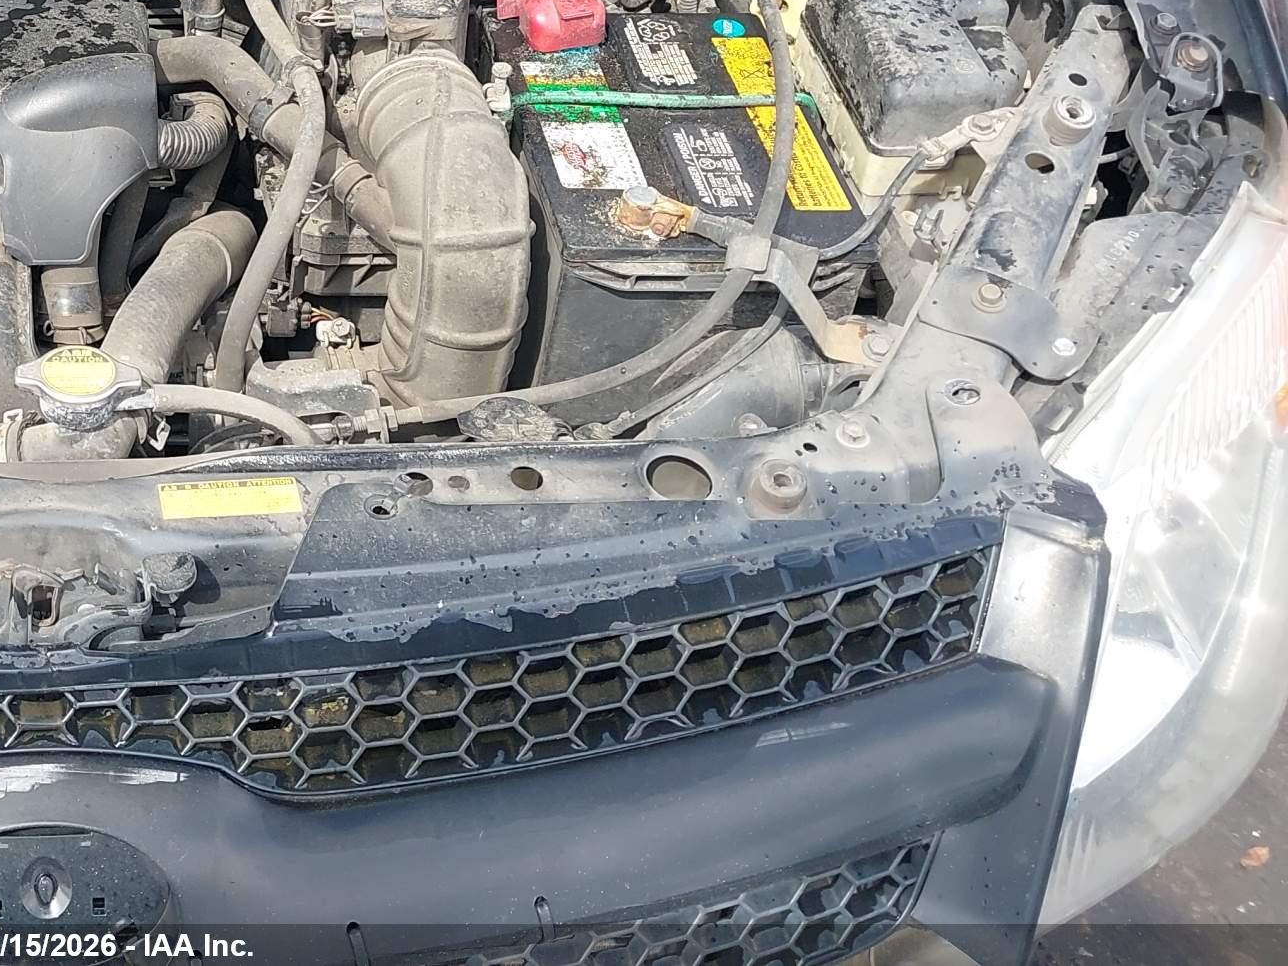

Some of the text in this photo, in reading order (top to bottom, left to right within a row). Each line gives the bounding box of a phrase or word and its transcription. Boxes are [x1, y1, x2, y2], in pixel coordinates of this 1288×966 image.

[673, 133, 691, 160] POISON
[688, 166, 709, 196] DANGER
[199, 481, 240, 490] CAUTION
